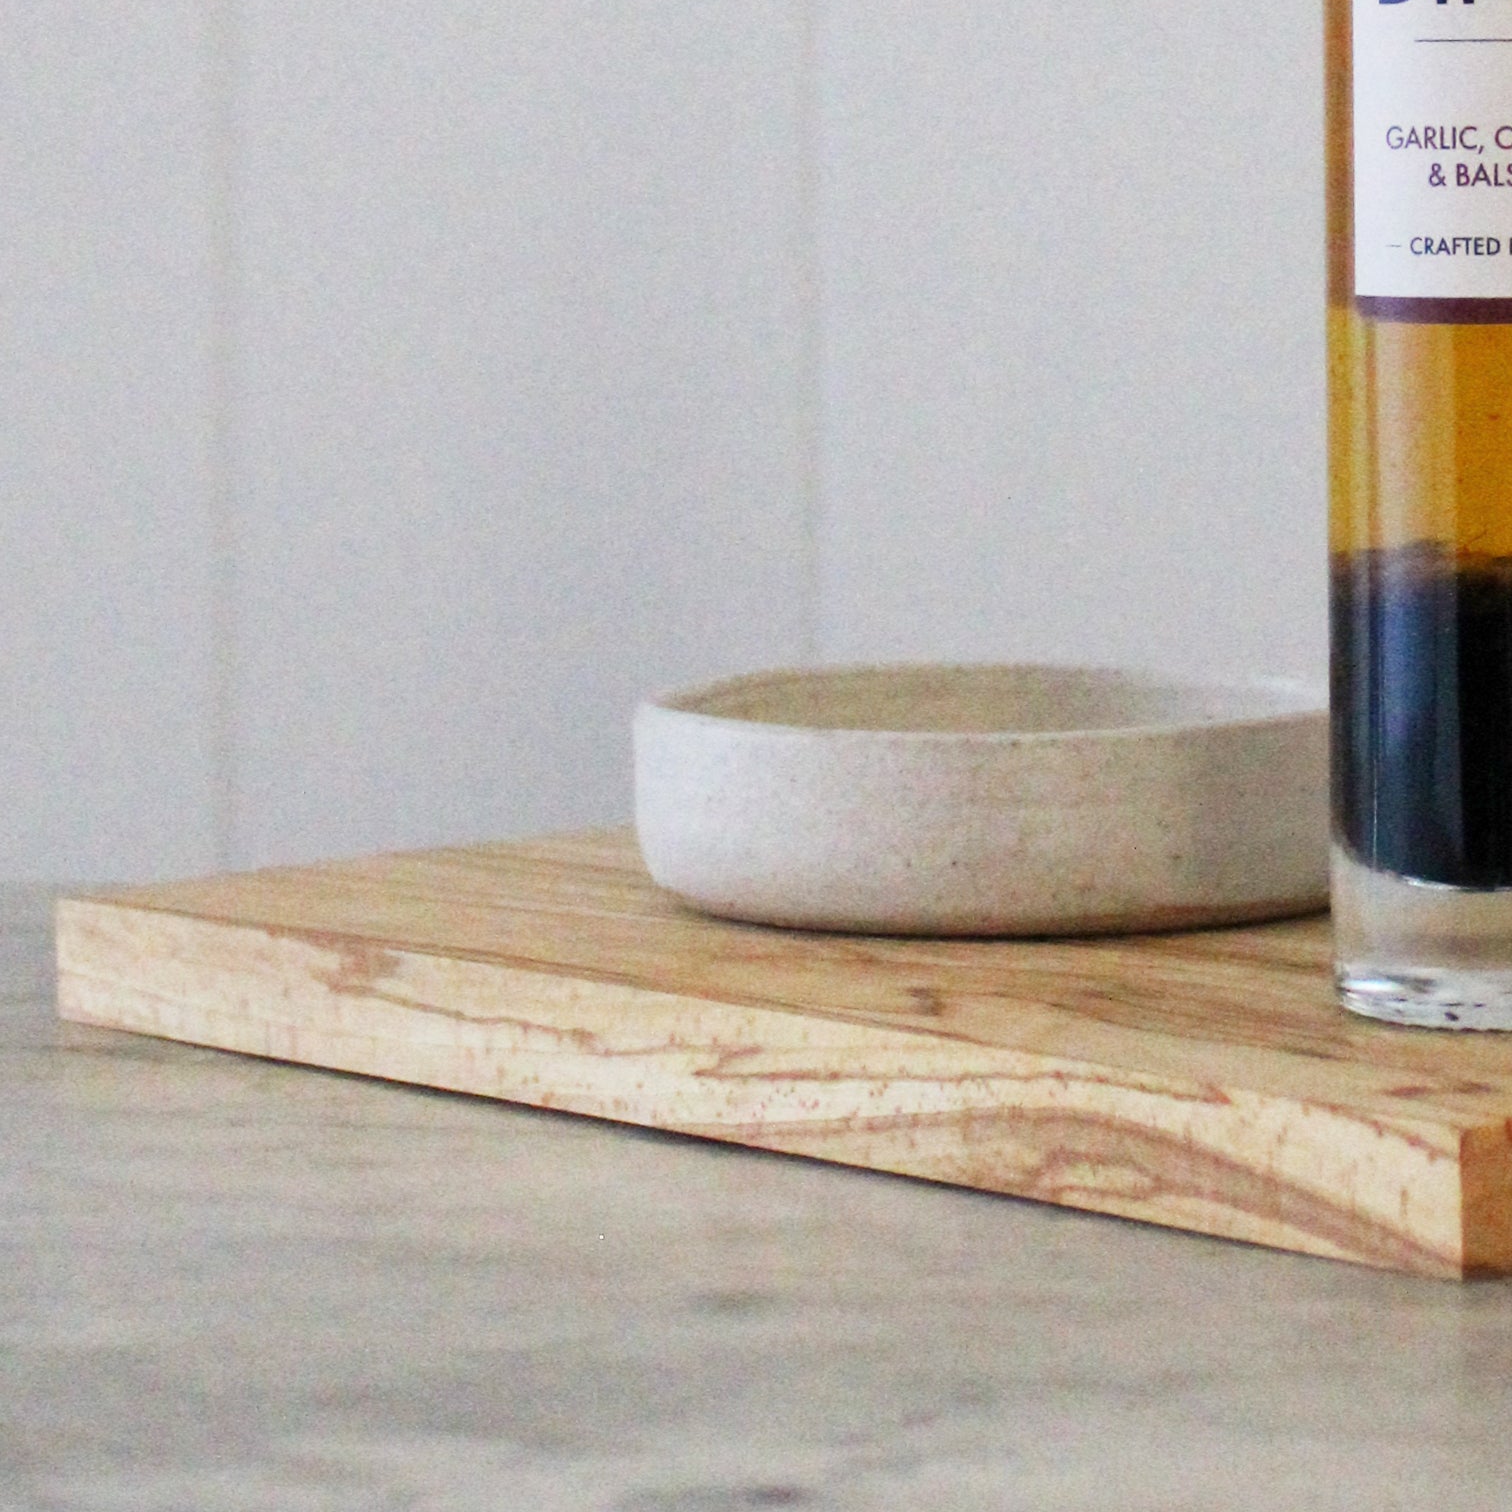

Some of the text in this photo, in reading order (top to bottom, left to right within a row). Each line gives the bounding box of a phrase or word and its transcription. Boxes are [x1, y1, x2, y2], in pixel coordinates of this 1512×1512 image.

[1385, 125, 1485, 155] GARLIC,
[1427, 162, 1447, 187] &
[1409, 235, 1501, 256] CRAFTED
